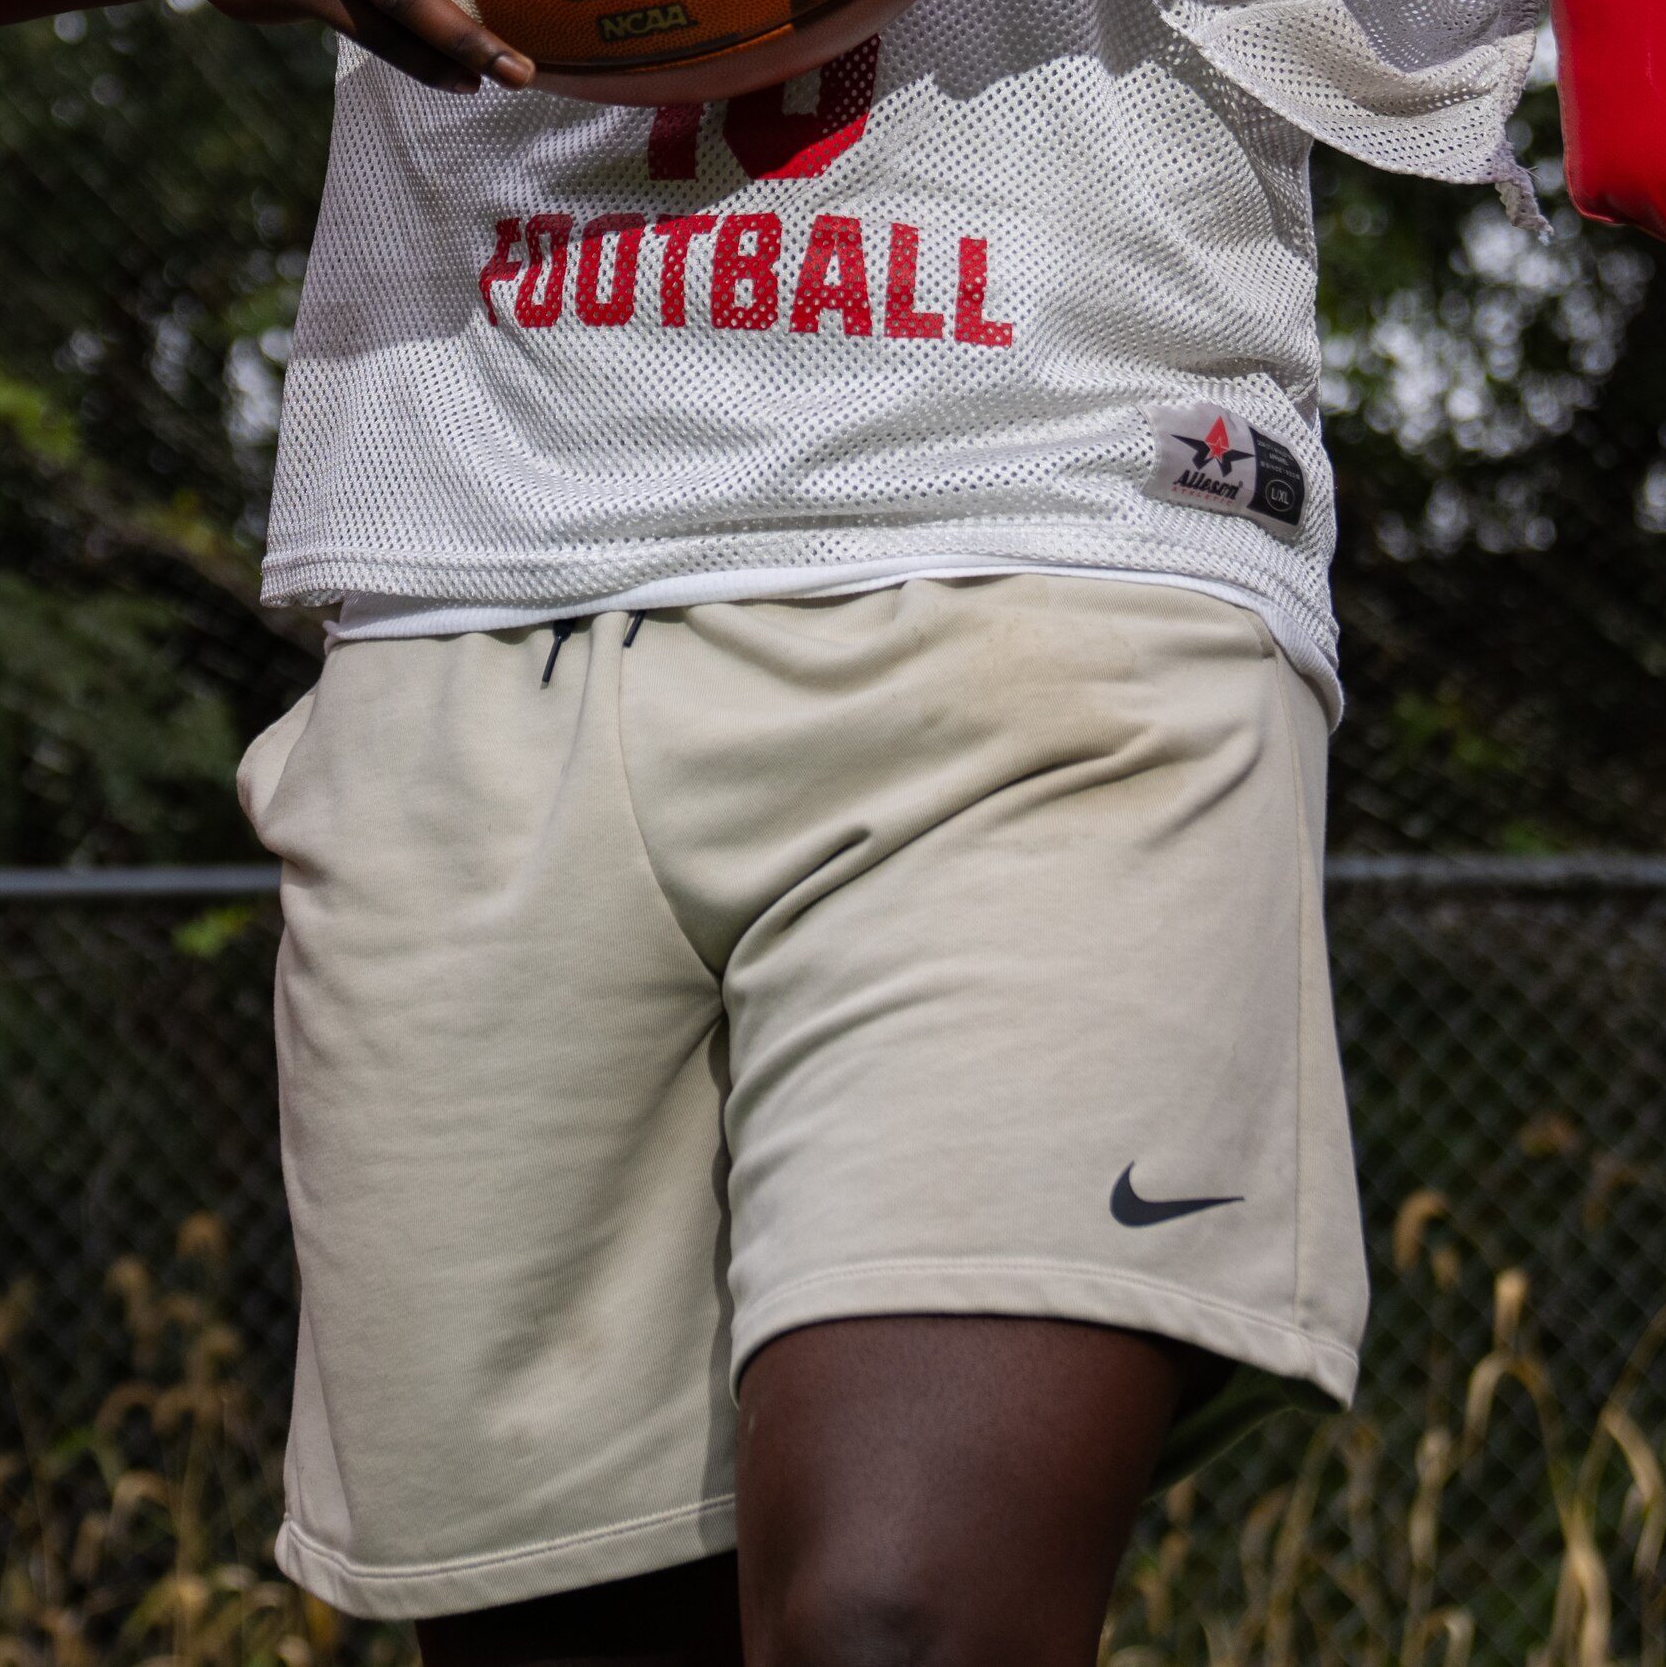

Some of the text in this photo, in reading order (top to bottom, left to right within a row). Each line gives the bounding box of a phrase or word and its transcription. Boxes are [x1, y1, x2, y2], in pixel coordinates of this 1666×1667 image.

[600, 3, 689, 40] NCAA
[479, 212, 1013, 347] FOOTBALL
[1270, 487, 1291, 505] L/XL
